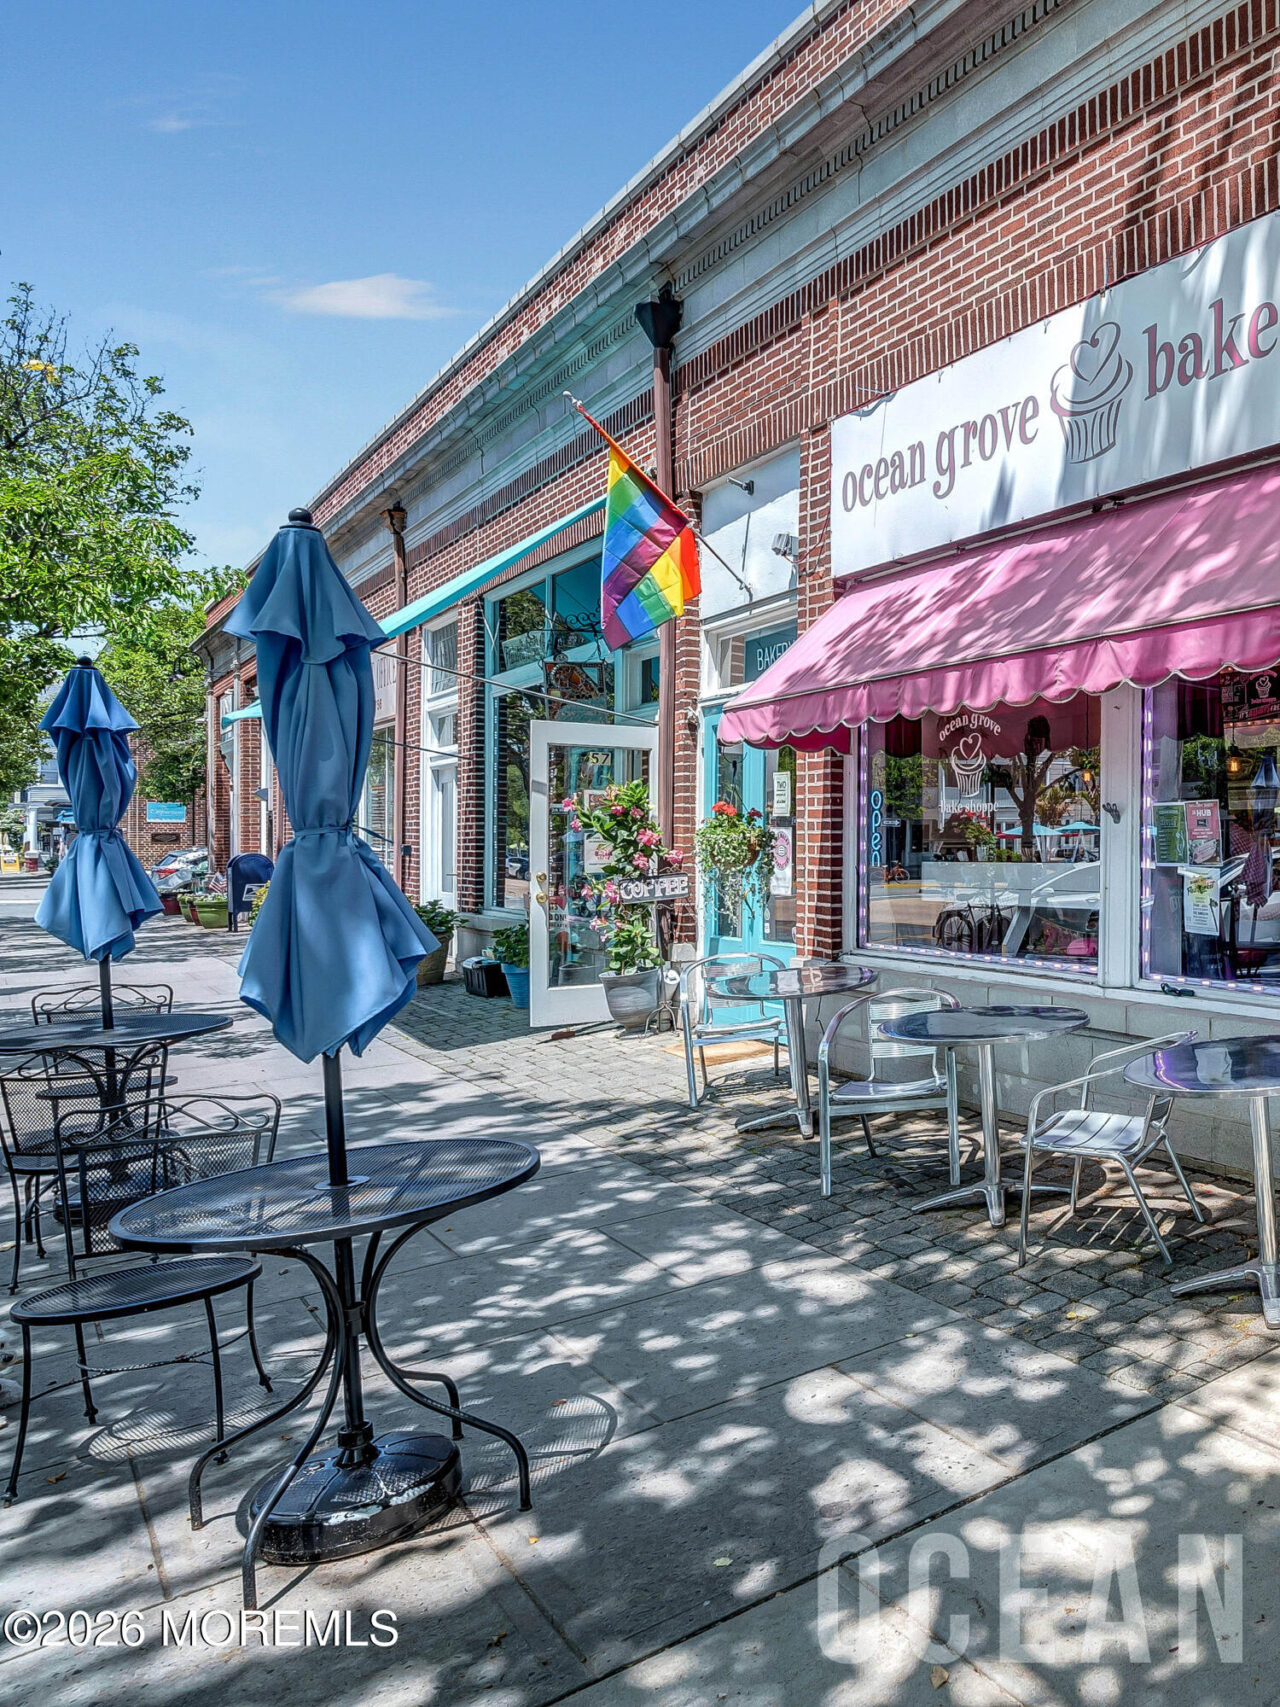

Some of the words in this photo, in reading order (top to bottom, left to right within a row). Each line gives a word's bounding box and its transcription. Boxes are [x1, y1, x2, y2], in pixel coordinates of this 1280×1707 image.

[842, 440, 927, 513] ocean
[932, 395, 1040, 500] grove
[1141, 297, 1279, 401] bake
[757, 640, 796, 671] BAKER
[939, 714, 969, 742] ocean
[969, 713, 1001, 736] grove
[591, 752, 610, 764] 57
[965, 799, 999, 818] shoppe
[619, 875, 689, 900] COFFEE
